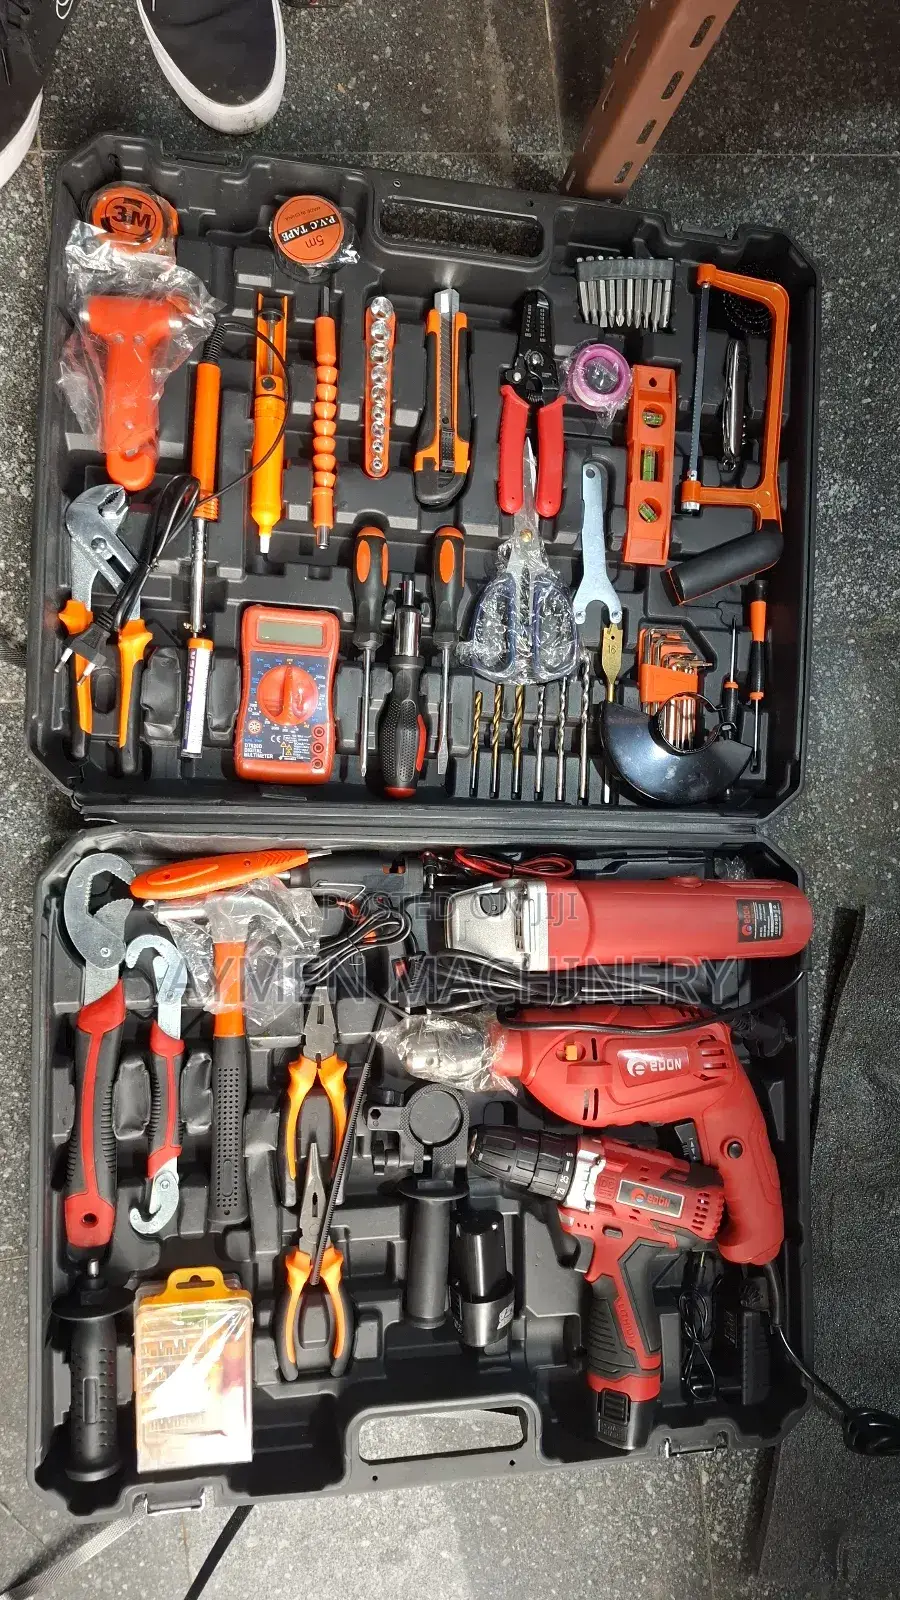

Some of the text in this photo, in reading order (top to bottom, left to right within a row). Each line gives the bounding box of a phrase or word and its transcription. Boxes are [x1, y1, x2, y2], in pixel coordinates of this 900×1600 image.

[111, 204, 152, 230] 3M
[281, 215, 336, 242] P.V.C TAPE
[305, 234, 325, 249] 5m
[608, 644, 617, 655] 16
